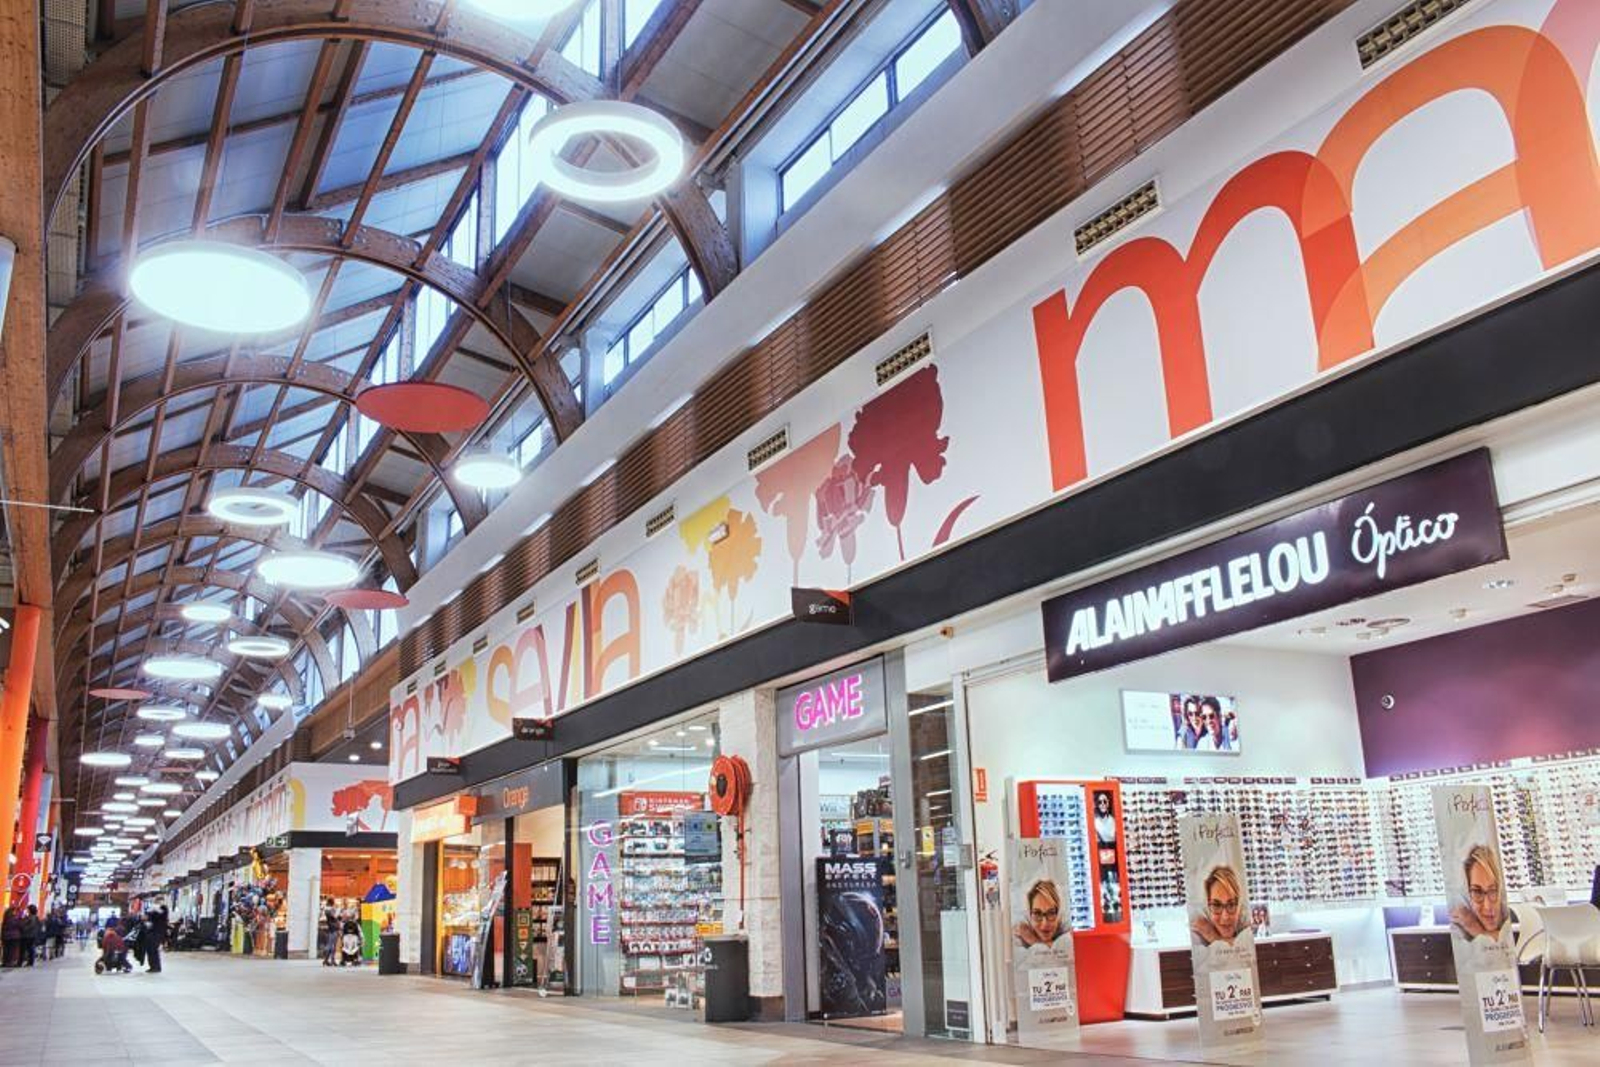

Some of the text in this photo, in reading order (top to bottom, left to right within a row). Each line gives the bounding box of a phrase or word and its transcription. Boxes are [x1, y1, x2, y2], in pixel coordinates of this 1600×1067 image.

[1351, 501, 1459, 580] Óptico
[794, 673, 864, 732] GAME
[503, 785, 529, 811] Orange
[824, 862, 877, 874] MASS
[587, 819, 615, 945] GAME
[824, 872, 877, 880] EFFECT
[1032, 985, 1042, 994] TU
[1215, 990, 1226, 1000] TU
[1482, 996, 1495, 1007] TU
